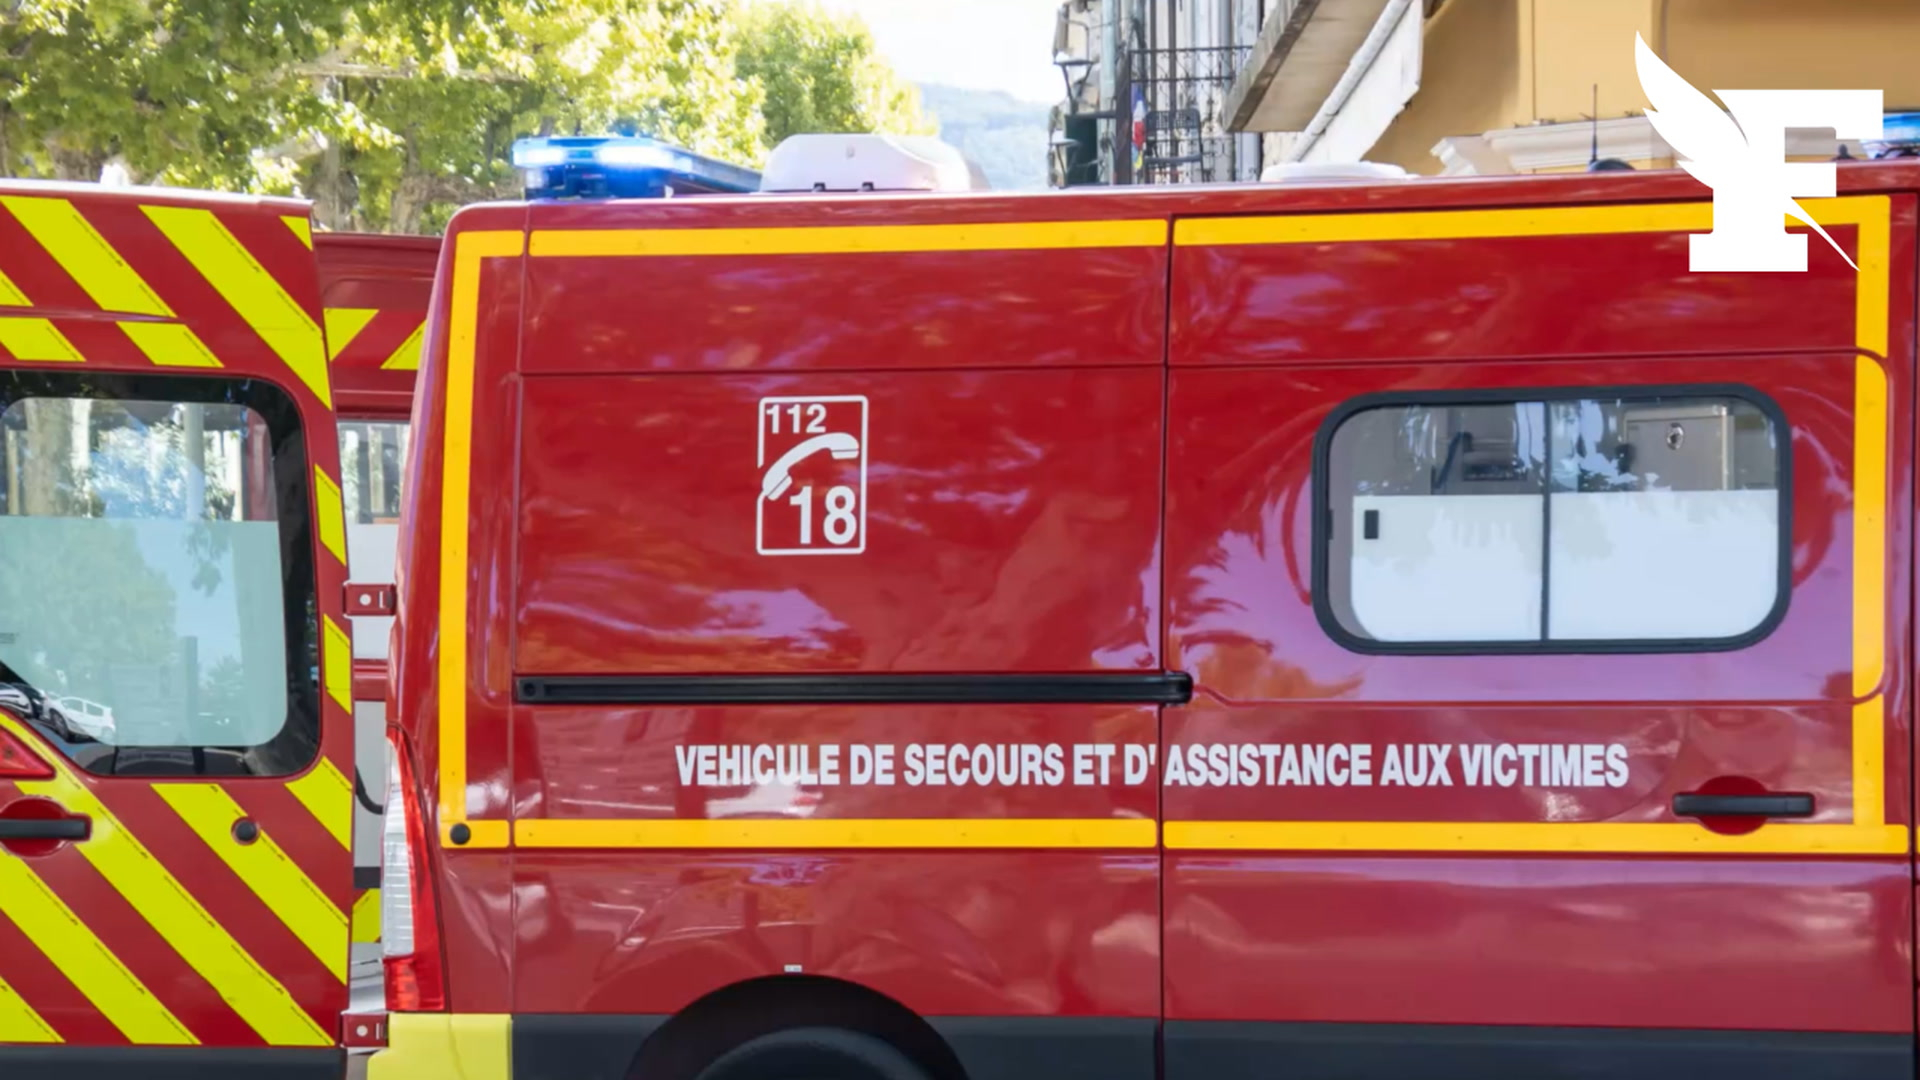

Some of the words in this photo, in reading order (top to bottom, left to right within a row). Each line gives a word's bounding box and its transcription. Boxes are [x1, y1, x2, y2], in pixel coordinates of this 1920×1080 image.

[766, 403, 827, 434] 112
[789, 485, 858, 545] 18
[675, 744, 841, 786] VEHICULE
[850, 744, 895, 786] DE
[904, 743, 1065, 787] SECOURS
[1073, 744, 1116, 786] ET
[1380, 744, 1454, 787] AUX
[1459, 743, 1630, 788] VICTIMES
